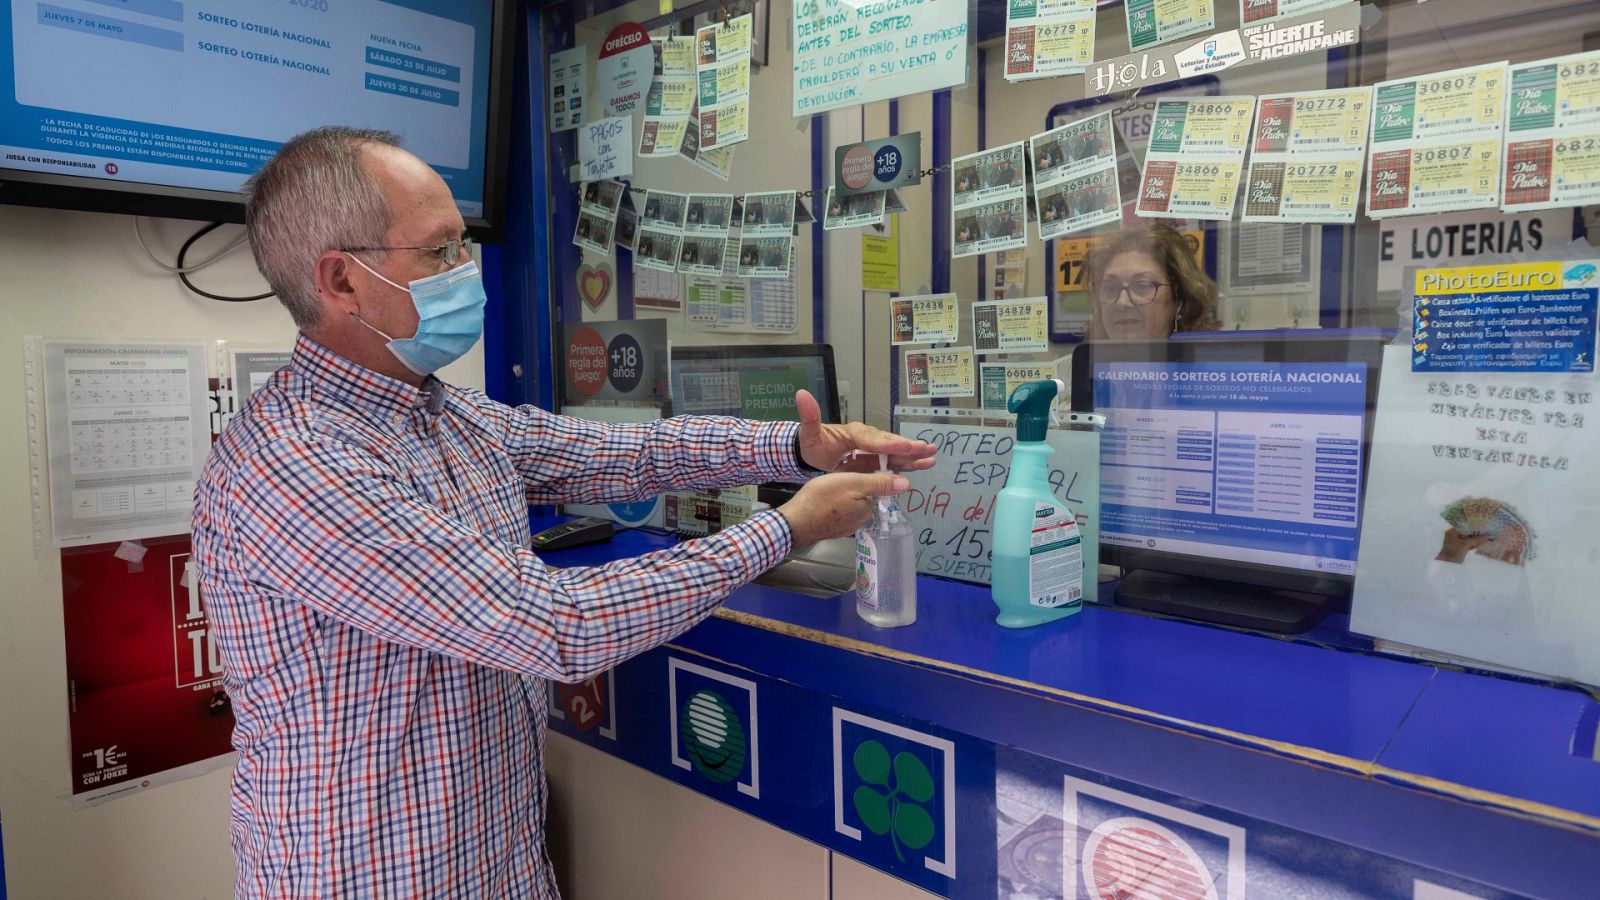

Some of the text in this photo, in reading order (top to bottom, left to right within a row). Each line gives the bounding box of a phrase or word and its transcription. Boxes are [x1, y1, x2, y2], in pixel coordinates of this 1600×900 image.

[43, 11, 76, 23] JUEVES
[85, 20, 97, 29] DE
[98, 22, 124, 34] MAYO
[198, 12, 331, 49] SORTEO LOTERÍA NACIONAL
[797, 9, 849, 37] DEBERÁN
[1243, 23, 1275, 38] QUE LA
[1037, 25, 1076, 37] 76779
[1249, 19, 1325, 51] SUERTE
[370, 34, 422, 52] NUEVA FECHA
[605, 32, 642, 51] OFRÉCELO
[798, 35, 831, 55] ANTES
[840, 26, 861, 43] DEL
[823, 23, 967, 66] LO LA EMPRESA
[1249, 29, 1355, 61] TE ACOMPAÑE
[198, 41, 331, 76] SORTEO LOTERÍA NACIONAL
[369, 51, 447, 76] SÁBADO 25 DE JULIO
[869, 51, 937, 75] A SU VENTA
[1211, 51, 1240, 63] Apuestas
[1204, 60, 1226, 71] Estado
[1089, 53, 1169, 96] Hola
[369, 78, 441, 99] JUEVES 30 DE JULIO
[1418, 76, 1477, 95] 30807
[610, 91, 641, 106] GANAMOS
[1517, 88, 1542, 100] Día
[1188, 103, 1232, 116] 34866
[1296, 98, 1346, 111] 20772
[1381, 103, 1402, 114] Día
[1516, 100, 1552, 116] Padre
[57, 120, 138, 137] FECHA CADUCIDAD
[1159, 117, 1176, 127] Día
[1263, 116, 1282, 127] Día
[1380, 113, 1411, 129] Padre
[41, 125, 78, 136] DURANTE
[590, 119, 624, 144] PAGOS
[1157, 128, 1179, 141] Padre
[1261, 127, 1289, 140] Padre
[46, 137, 214, 164] TODOS PARA
[1413, 147, 1472, 163] 30807
[6, 153, 26, 162] JUEGA
[42, 158, 96, 169] RESPONSABILIDAD
[876, 152, 897, 166] +18
[1512, 161, 1539, 173] Día
[877, 165, 896, 175] años
[1176, 165, 1219, 177] 34866
[1287, 165, 1338, 177] 20772
[1377, 169, 1398, 181] Día
[1148, 176, 1164, 187] Día
[1254, 179, 1273, 189] Día
[1375, 180, 1406, 196] Padre
[1511, 174, 1549, 189] Padre
[1145, 187, 1169, 200] Padre
[1251, 189, 1279, 204] Padre
[1380, 217, 1544, 261] E LOTERIAS
[1422, 268, 1556, 291] PhotoEuro
[1571, 292, 1591, 300] Euro
[913, 300, 944, 311] 47438
[997, 304, 1032, 316] 34879
[1475, 306, 1500, 316] Prüfen
[1518, 305, 1583, 314] Euro-Banknoten
[1543, 316, 1567, 325] billets
[1569, 316, 1589, 324] Euro
[1485, 329, 1582, 337] Euro banknotes validator
[1473, 341, 1512, 350] verificador
[1513, 341, 1523, 349] de
[1525, 341, 1553, 349] billetes
[1554, 340, 1574, 349] Euro
[571, 344, 637, 369] Primera +18
[928, 354, 959, 364] 92747
[569, 356, 635, 379] regla del años
[1006, 368, 1041, 379] 66084
[574, 370, 601, 386] juego:
[1098, 369, 1362, 385] CALENDARIO SORTEOS LOTERÍA NACIONAL
[1133, 383, 1166, 391] NUEVAS
[1167, 384, 1192, 392] FECHAS
[1204, 385, 1240, 393] SORTEOS
[1243, 385, 1257, 393] NO
[1258, 385, 1312, 394] CELEBRADOS
[1427, 381, 1480, 399] SOLO
[1564, 391, 1594, 405] EN
[1249, 395, 1269, 403] mayo
[1543, 410, 1585, 429] POR
[915, 429, 1015, 457] SORTEO
[1475, 426, 1528, 445] ESTA
[1431, 444, 1570, 471] VENTANILLA
[906, 484, 951, 519] DÍA
[962, 495, 998, 525] del
[918, 527, 937, 546] a
[193, 682, 211, 692] GANA
[93, 745, 118, 770] 1€
[83, 768, 128, 785] CON JOKER
